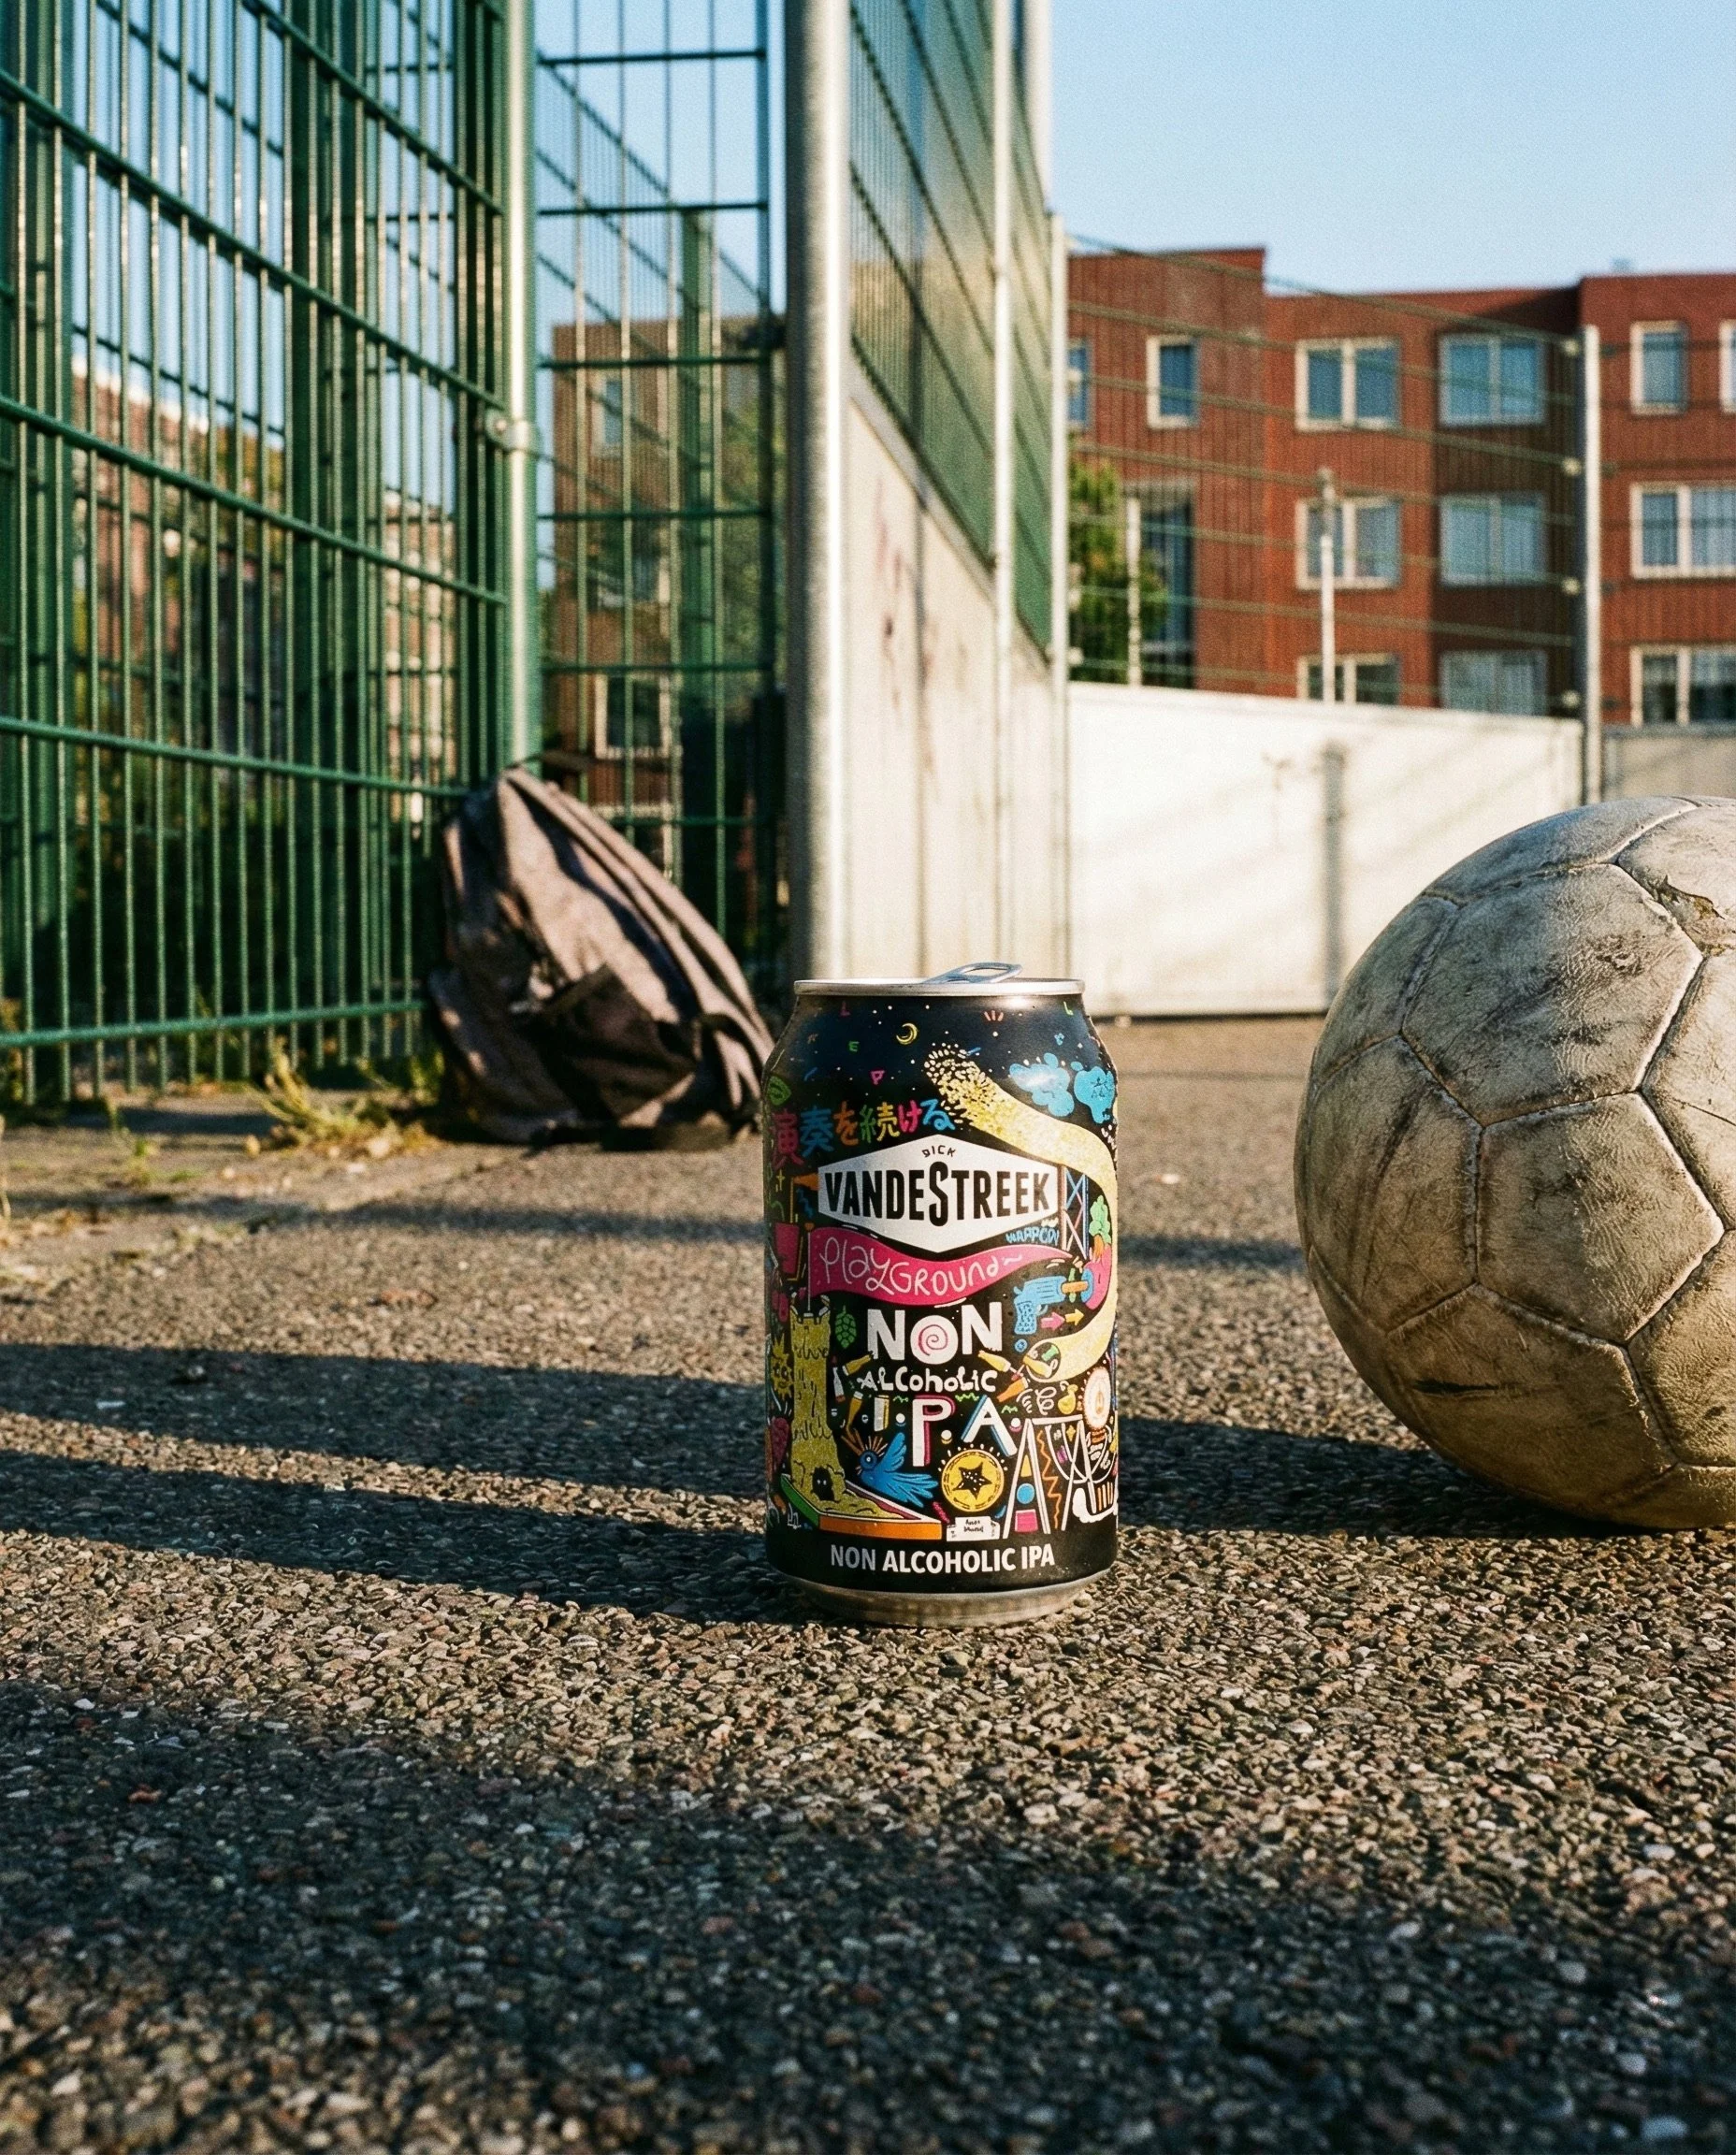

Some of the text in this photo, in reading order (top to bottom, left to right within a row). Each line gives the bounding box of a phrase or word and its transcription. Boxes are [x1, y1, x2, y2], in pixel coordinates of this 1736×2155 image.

[824, 1161, 1050, 1227] VANDESTREEK
[867, 1301, 1003, 1365] NON
[831, 1543, 1056, 1574] NON ALCOHOLIC IPA
